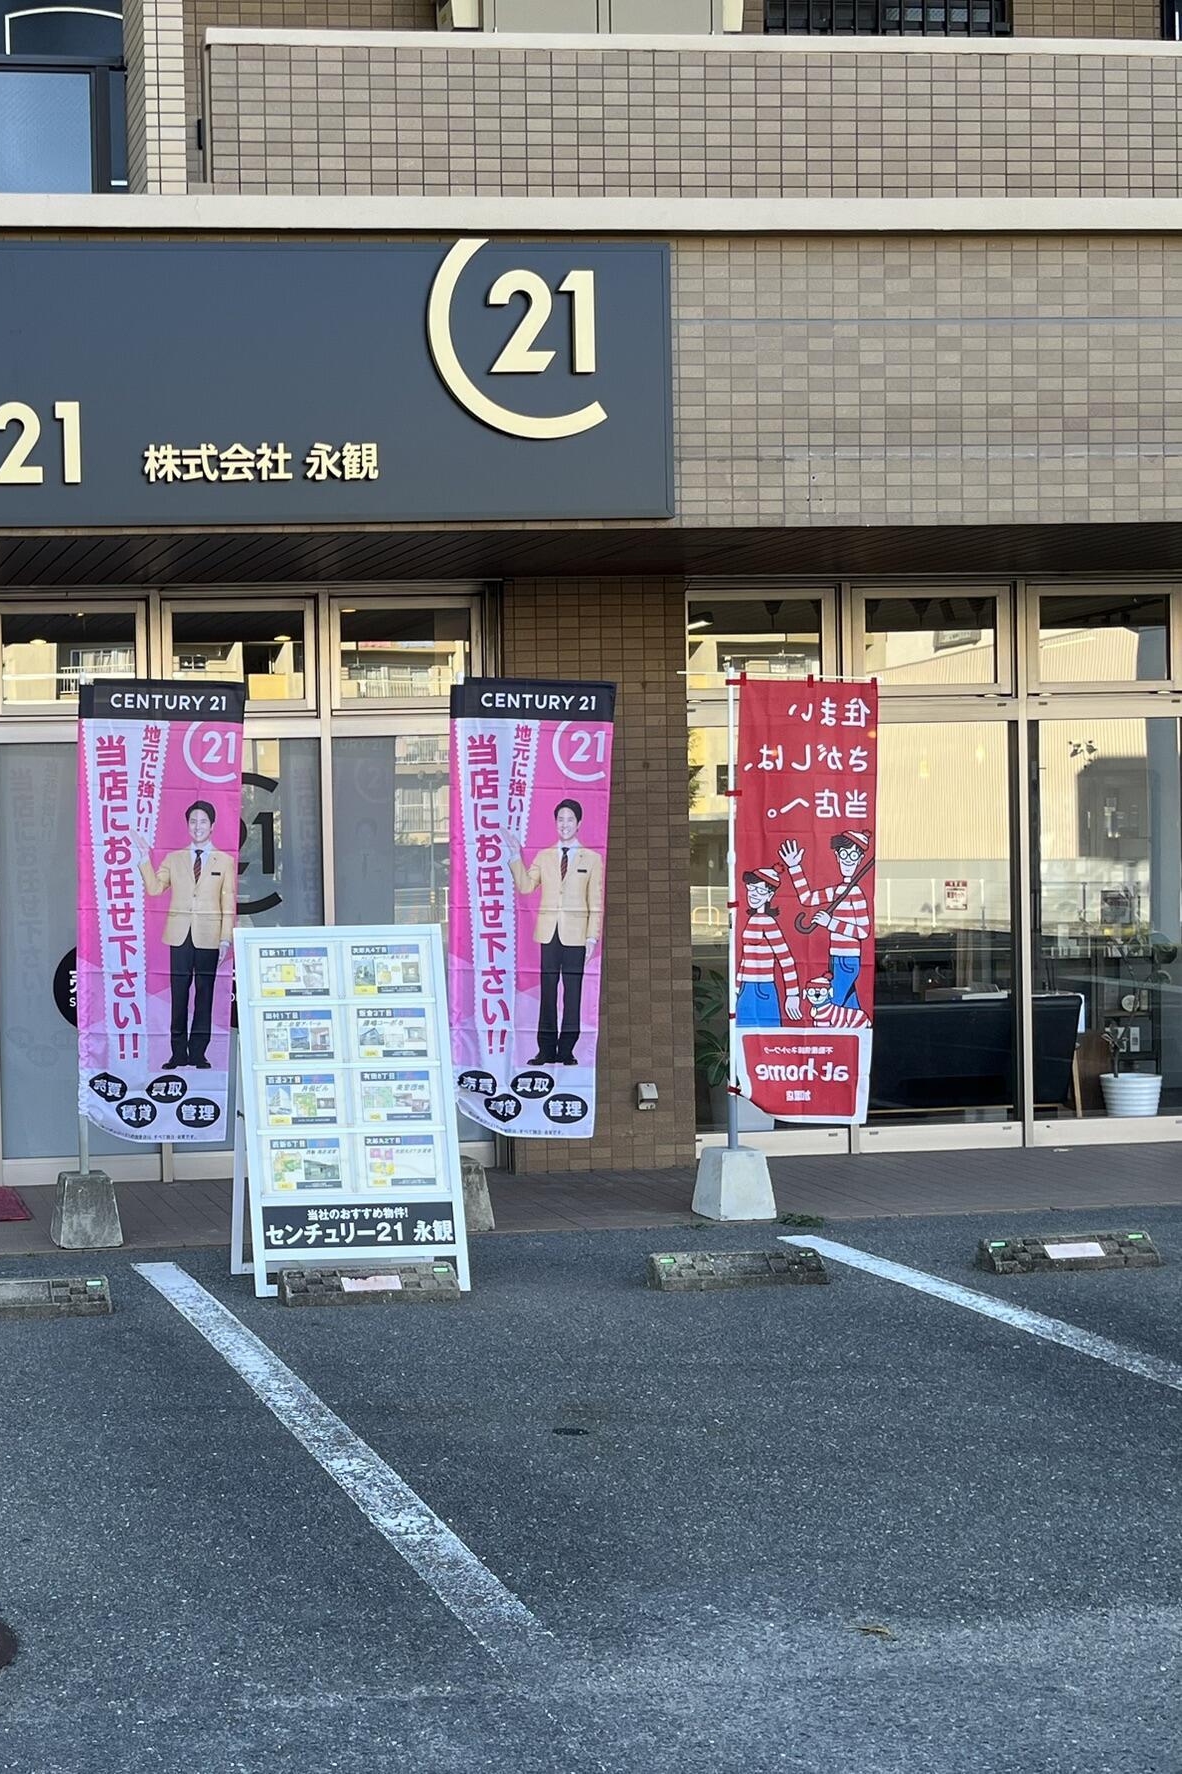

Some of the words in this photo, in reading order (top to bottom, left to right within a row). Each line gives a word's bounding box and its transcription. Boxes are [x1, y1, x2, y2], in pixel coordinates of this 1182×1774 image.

[142, 442, 293, 484] 株式会社
[304, 442, 379, 483] 永観
[110, 693, 205, 711] CENTURY
[210, 695, 227, 711] 21
[480, 692, 575, 711] CENTURY
[579, 695, 596, 711] 21
[151, 1081, 183, 1097] 買取
[516, 1077, 549, 1093] 買取
[181, 1104, 215, 1121] 管理
[548, 1101, 582, 1118] 管理
[265, 1222, 404, 1245] センチュリー21
[413, 1219, 454, 1242] 永観
